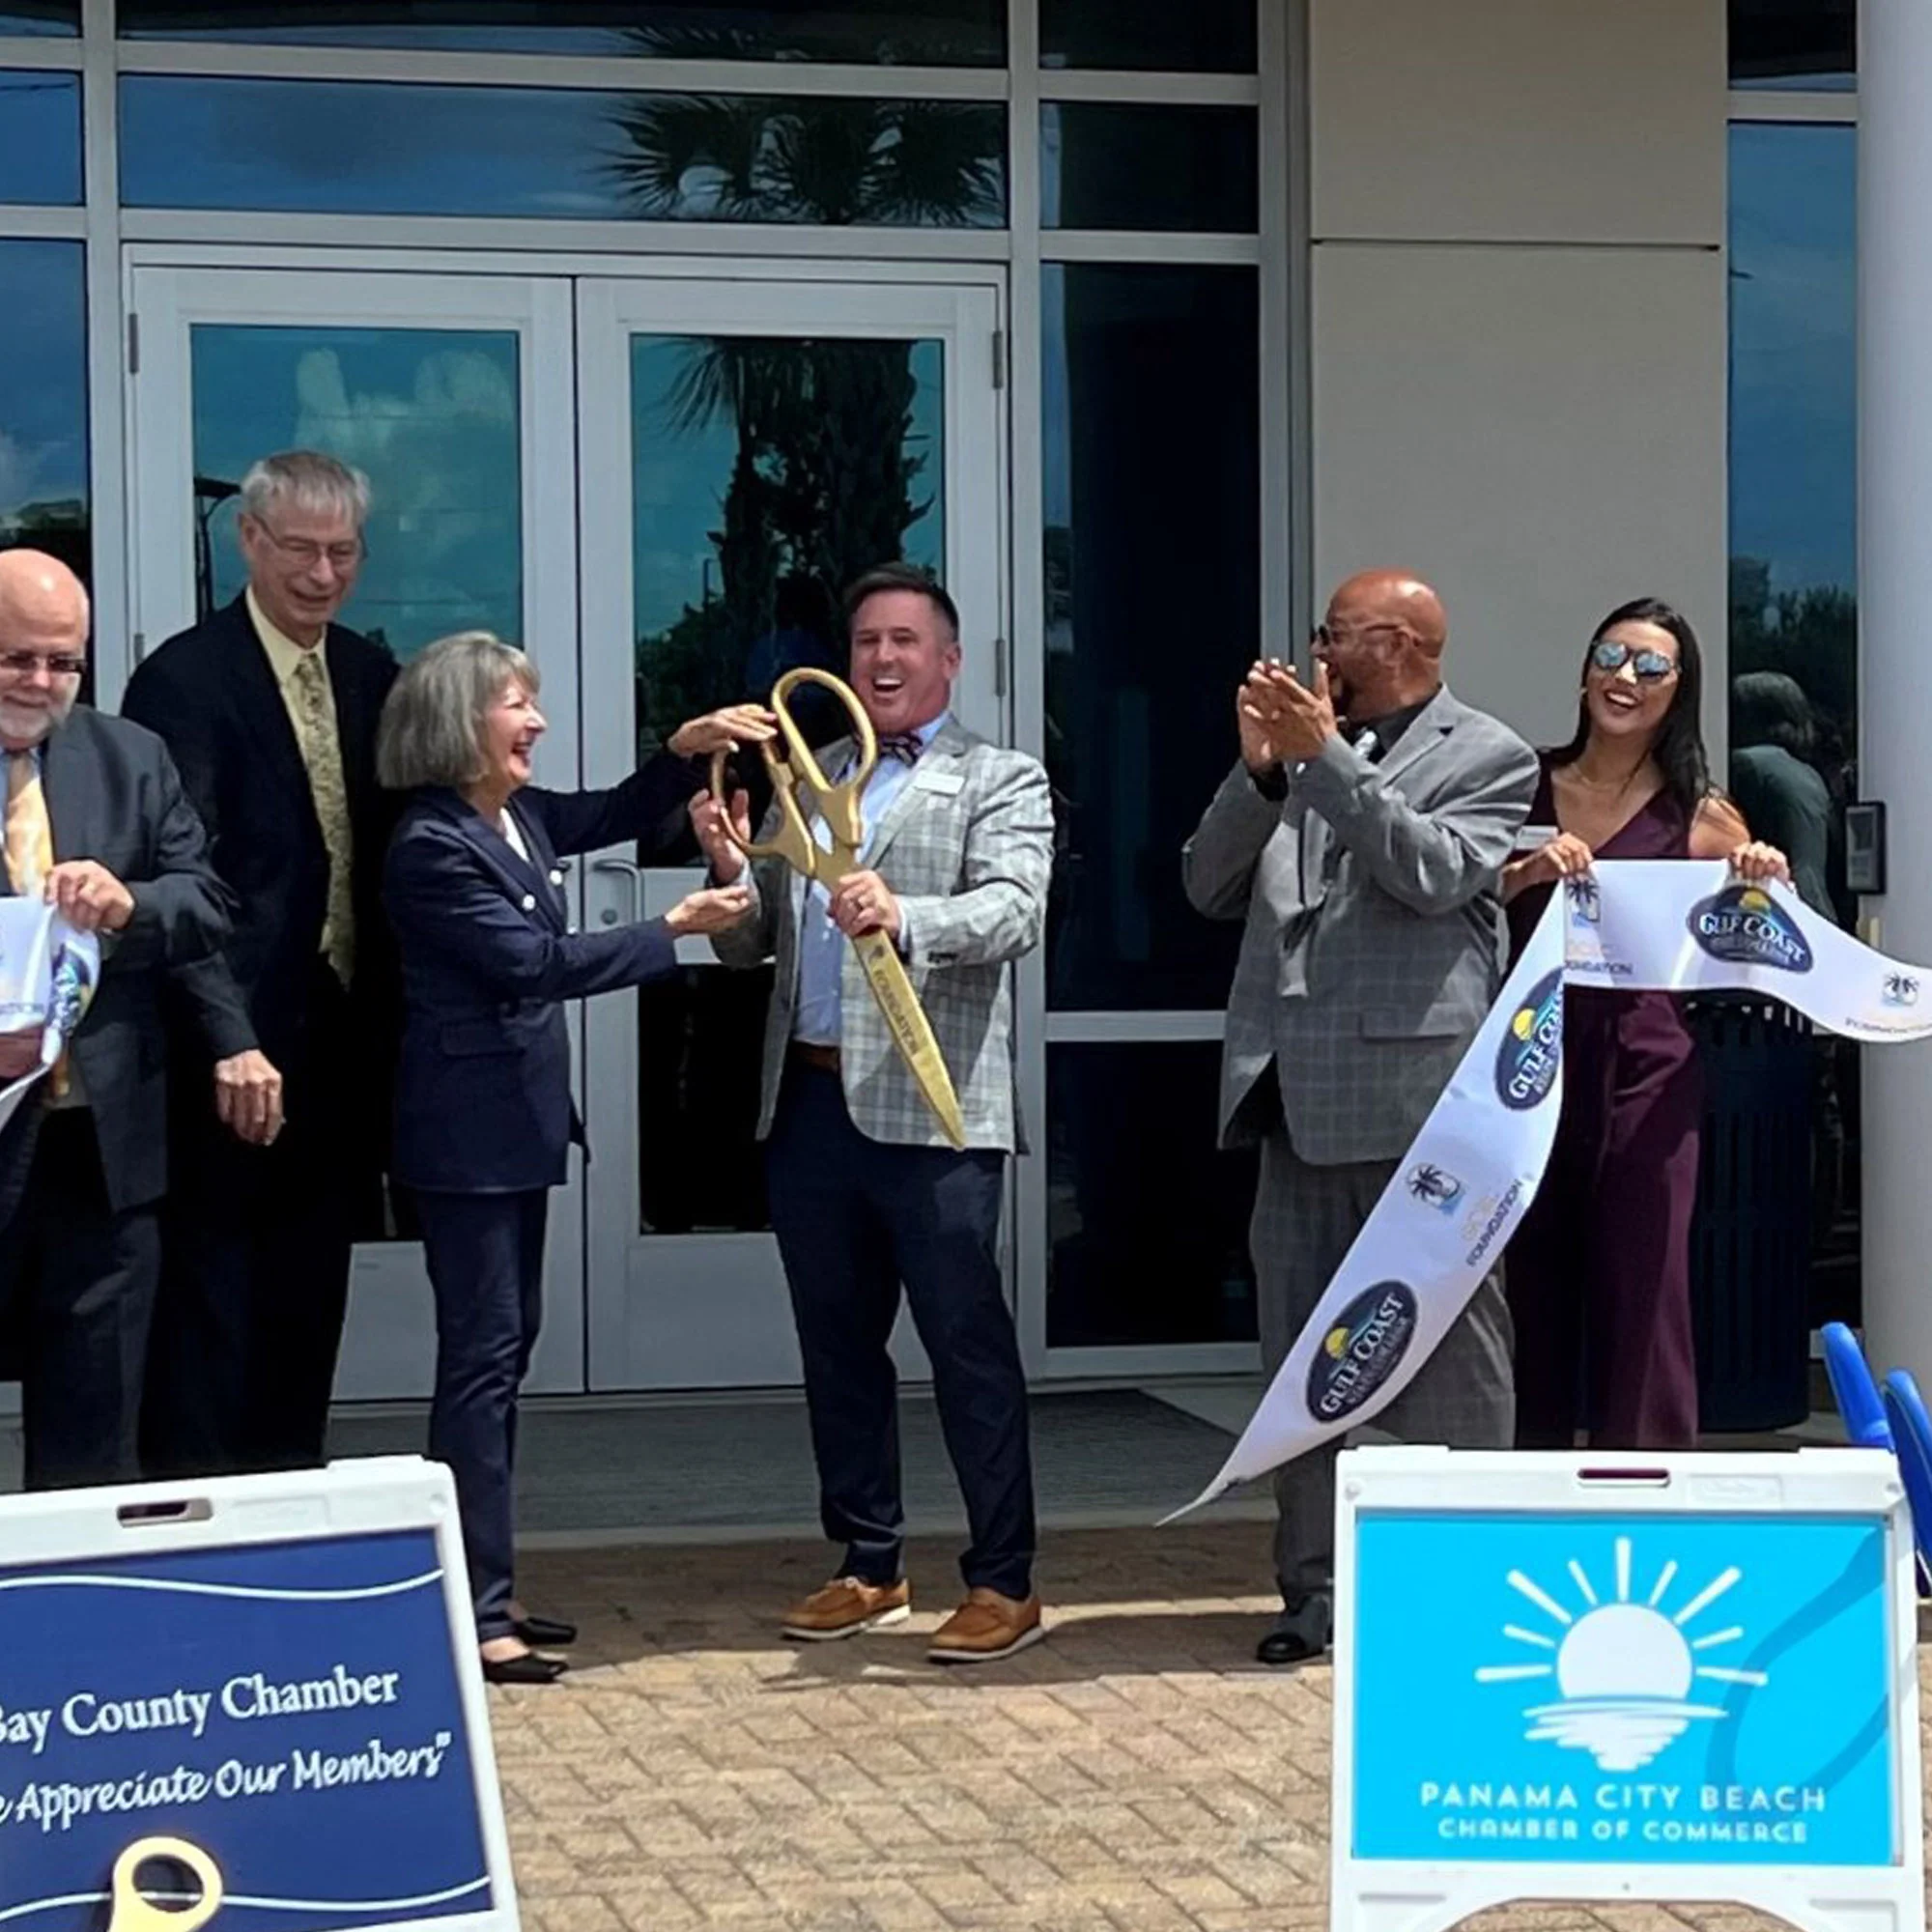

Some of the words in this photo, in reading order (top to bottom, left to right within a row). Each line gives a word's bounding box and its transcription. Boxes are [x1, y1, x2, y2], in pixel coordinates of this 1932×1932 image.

[1509, 1041, 1546, 1098] GULF
[1320, 1358, 1361, 1412] GULF
[1353, 1292, 1404, 1361] COAST
[0, 1704, 52, 1754] ay
[62, 1690, 212, 1739] County
[221, 1665, 399, 1719] Chamber
[15, 1766, 212, 1833] Appreciate
[214, 1758, 287, 1798] Our
[1420, 1781, 1577, 1809] PANAMA
[1595, 1783, 1680, 1808] CITY
[1700, 1784, 1825, 1811] BEACH
[1438, 1817, 1578, 1839] CHAMBER
[1592, 1820, 1629, 1839] OF
[1643, 1821, 1807, 1843] COMMERCE
